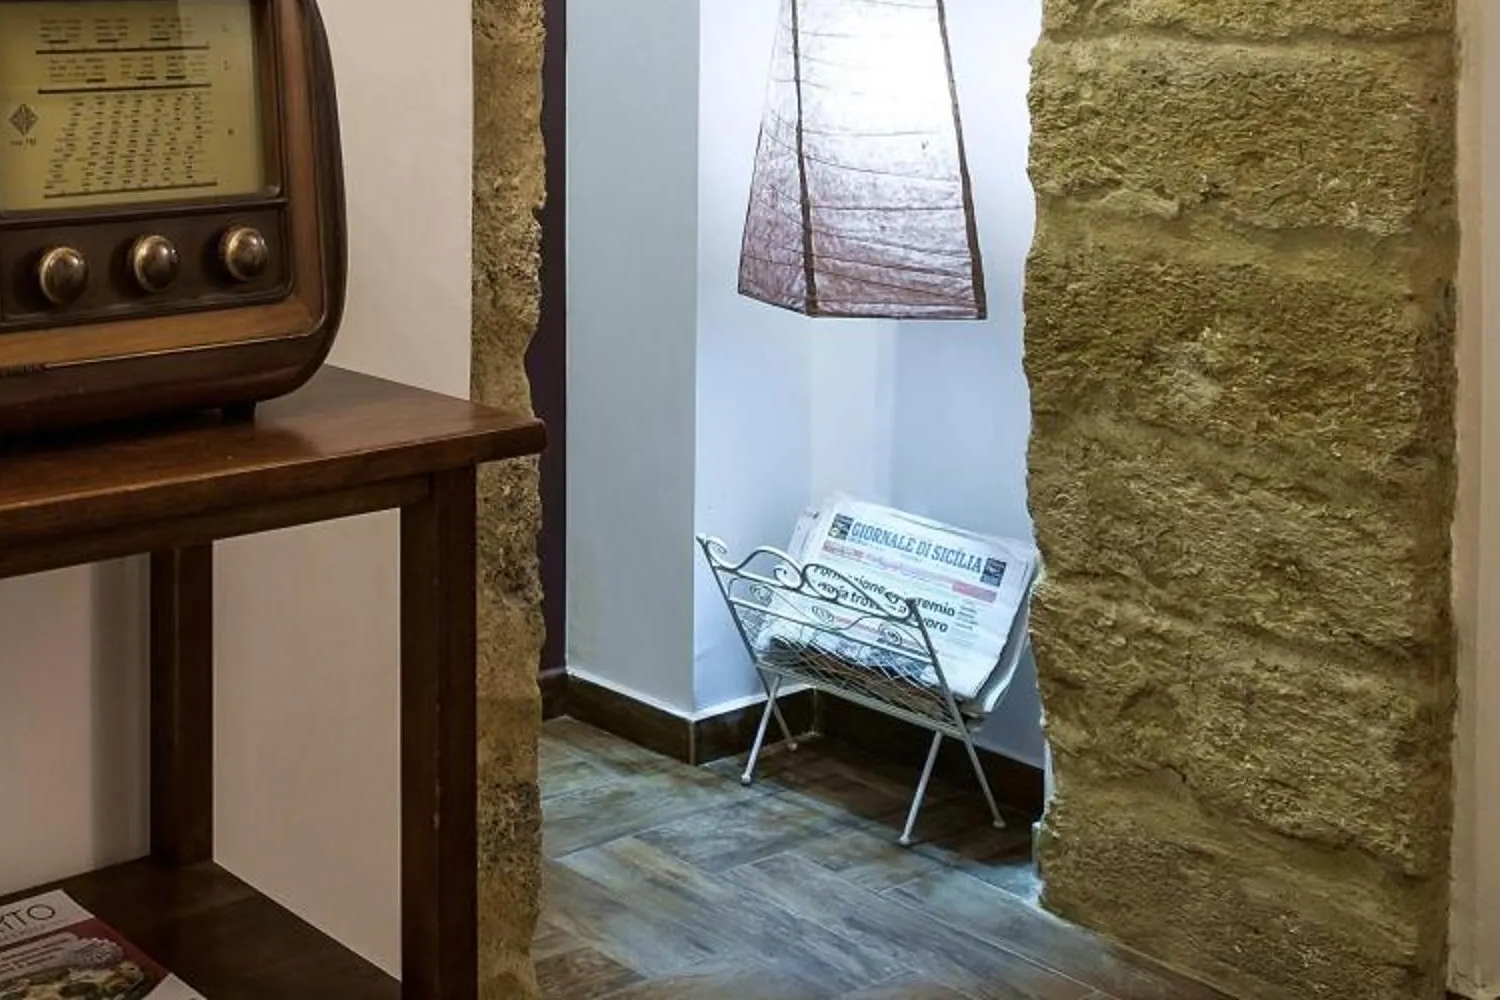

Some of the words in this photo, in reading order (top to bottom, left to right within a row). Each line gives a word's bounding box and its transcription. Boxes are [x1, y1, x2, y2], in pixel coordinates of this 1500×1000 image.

[851, 521, 918, 554] GIORNALE
[915, 540, 930, 557] DI
[931, 544, 983, 574] SICILIA
